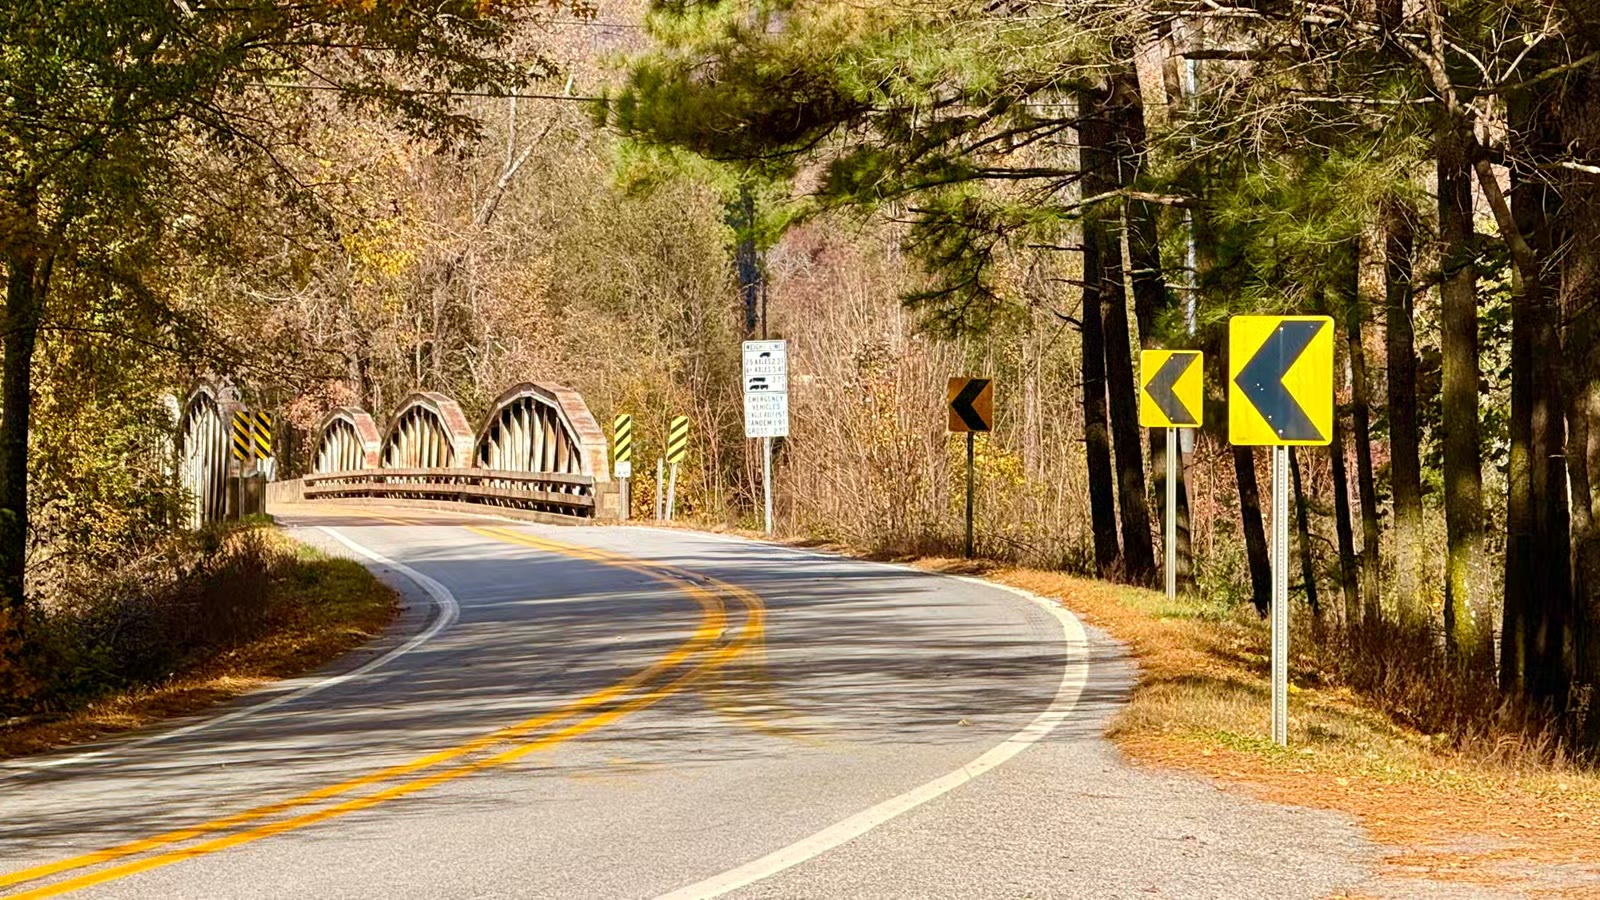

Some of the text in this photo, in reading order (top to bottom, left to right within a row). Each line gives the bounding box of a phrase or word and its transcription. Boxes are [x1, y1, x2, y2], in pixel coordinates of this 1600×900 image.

[748, 395, 784, 403] EMERGENCY
[751, 403, 781, 411] VEHICLES
[747, 419, 772, 427] TANDEM
[747, 427, 770, 435] GROSS
